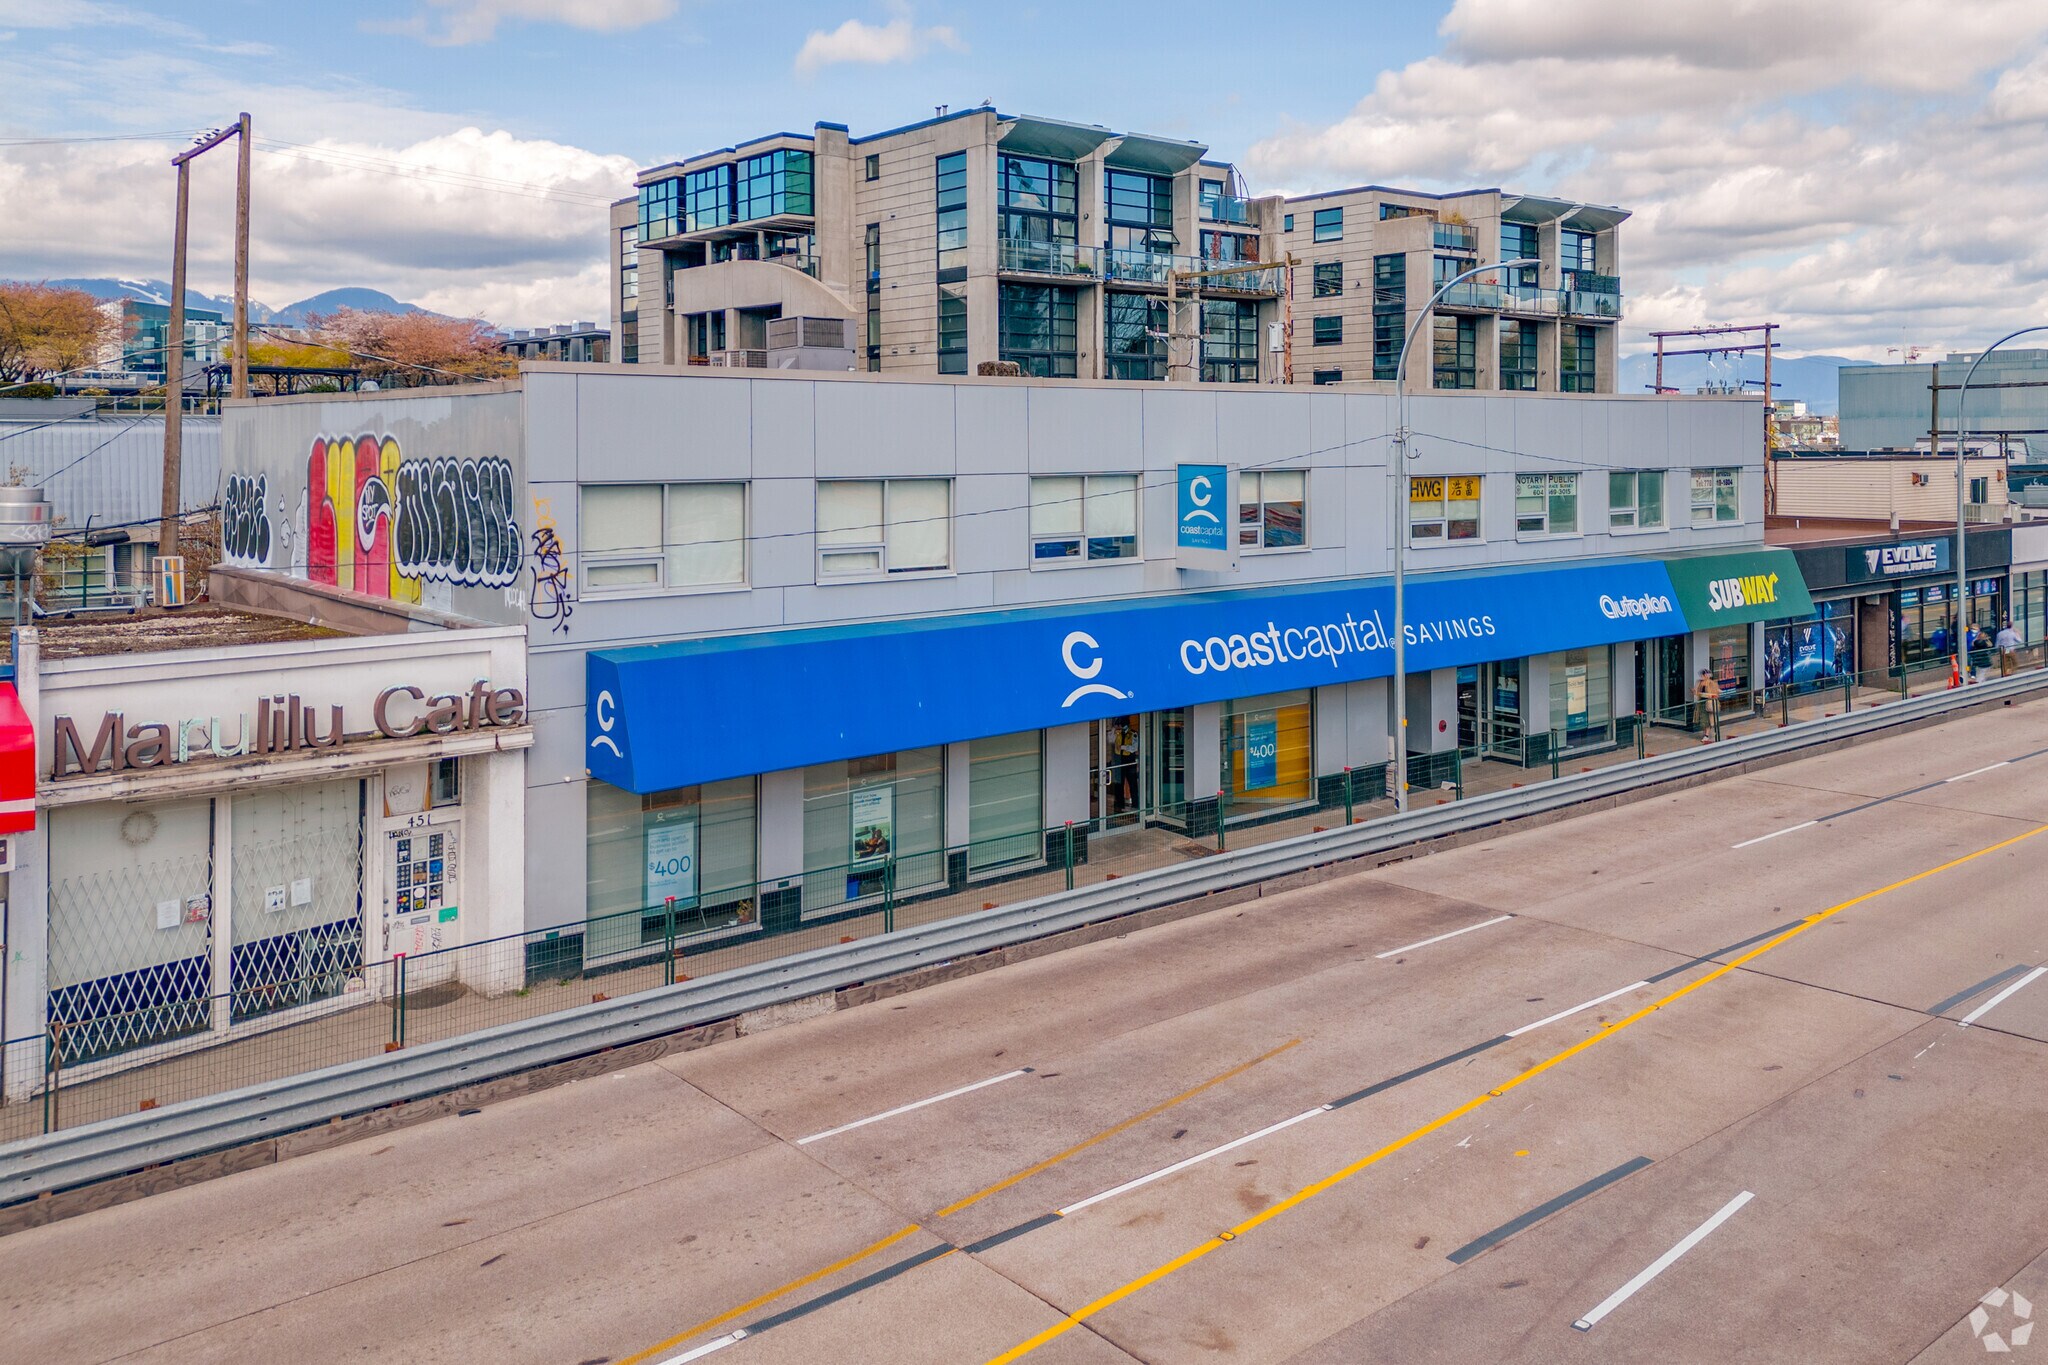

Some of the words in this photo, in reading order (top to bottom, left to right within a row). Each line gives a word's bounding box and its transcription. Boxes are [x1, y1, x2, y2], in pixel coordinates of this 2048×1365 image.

[1410, 480, 1442, 498] HWG
[1515, 476, 1544, 485] NOTARY
[1549, 475, 1575, 484] PUBLIC
[1882, 543, 1937, 564] EVOLVE
[1708, 571, 1779, 613] SUBWAY
[1402, 615, 1496, 646] SAVINGS
[53, 692, 344, 782] Marulilu
[373, 675, 524, 738] Cafe
[1249, 743, 1275, 758] $400
[407, 813, 432, 828] 451
[648, 855, 691, 877] $400
